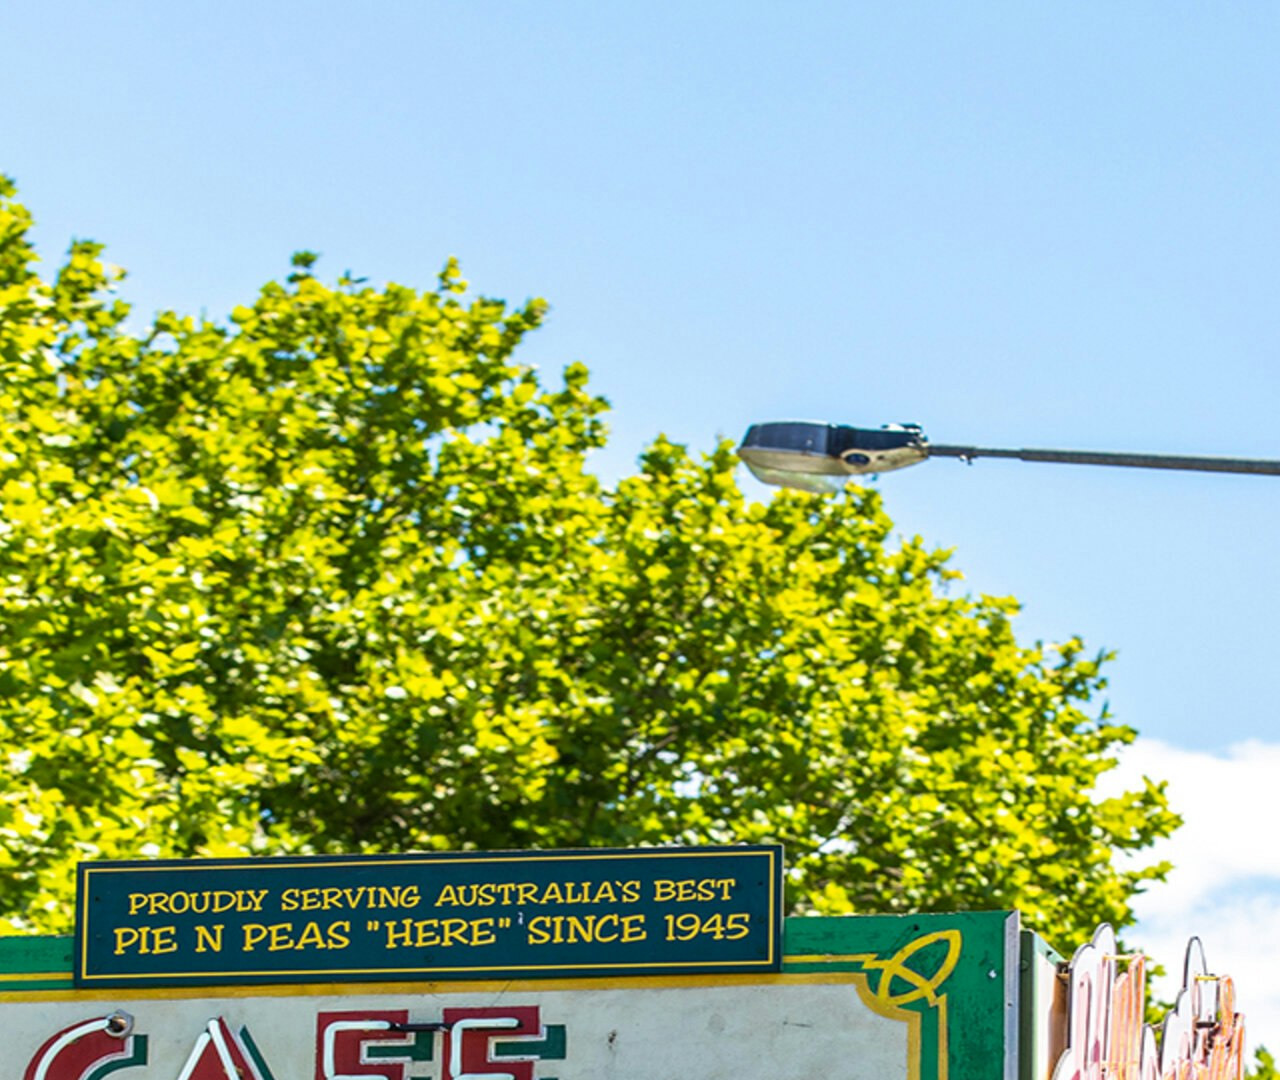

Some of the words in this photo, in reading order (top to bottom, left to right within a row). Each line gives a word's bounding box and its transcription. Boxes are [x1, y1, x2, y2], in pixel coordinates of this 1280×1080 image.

[128, 889, 268, 915] PROUDLY
[281, 885, 421, 911] SERVING
[434, 880, 641, 907] AUSTRALIA'S
[654, 878, 736, 902] BEST
[113, 926, 178, 955] PIE
[194, 924, 225, 953] N
[242, 920, 350, 952] PEAS
[367, 917, 511, 949] "HERE"
[527, 913, 647, 945] SINCE
[664, 912, 750, 942] 1945
